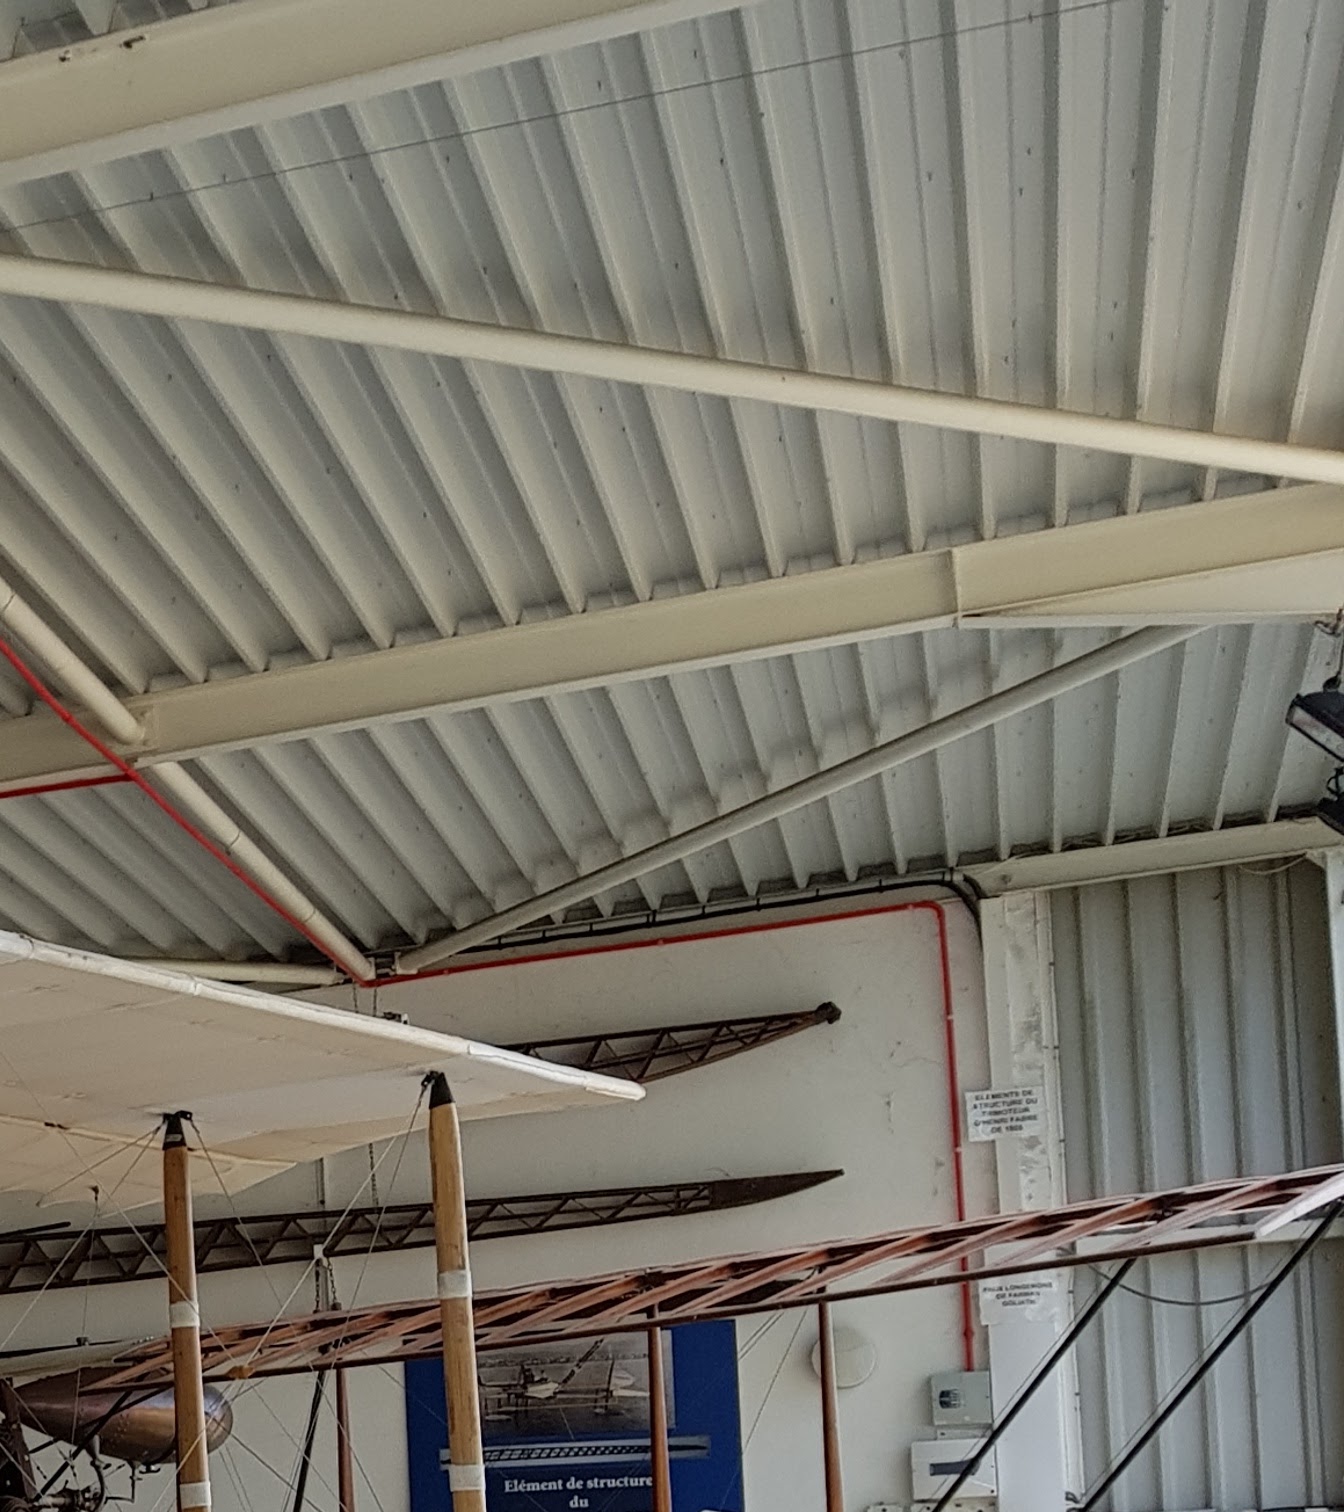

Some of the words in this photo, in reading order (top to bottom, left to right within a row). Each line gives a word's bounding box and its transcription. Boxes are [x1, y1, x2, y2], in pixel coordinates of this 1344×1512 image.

[566, 1476, 584, 1490] de
[586, 1475, 653, 1489] structure
[569, 1495, 589, 1508] du
